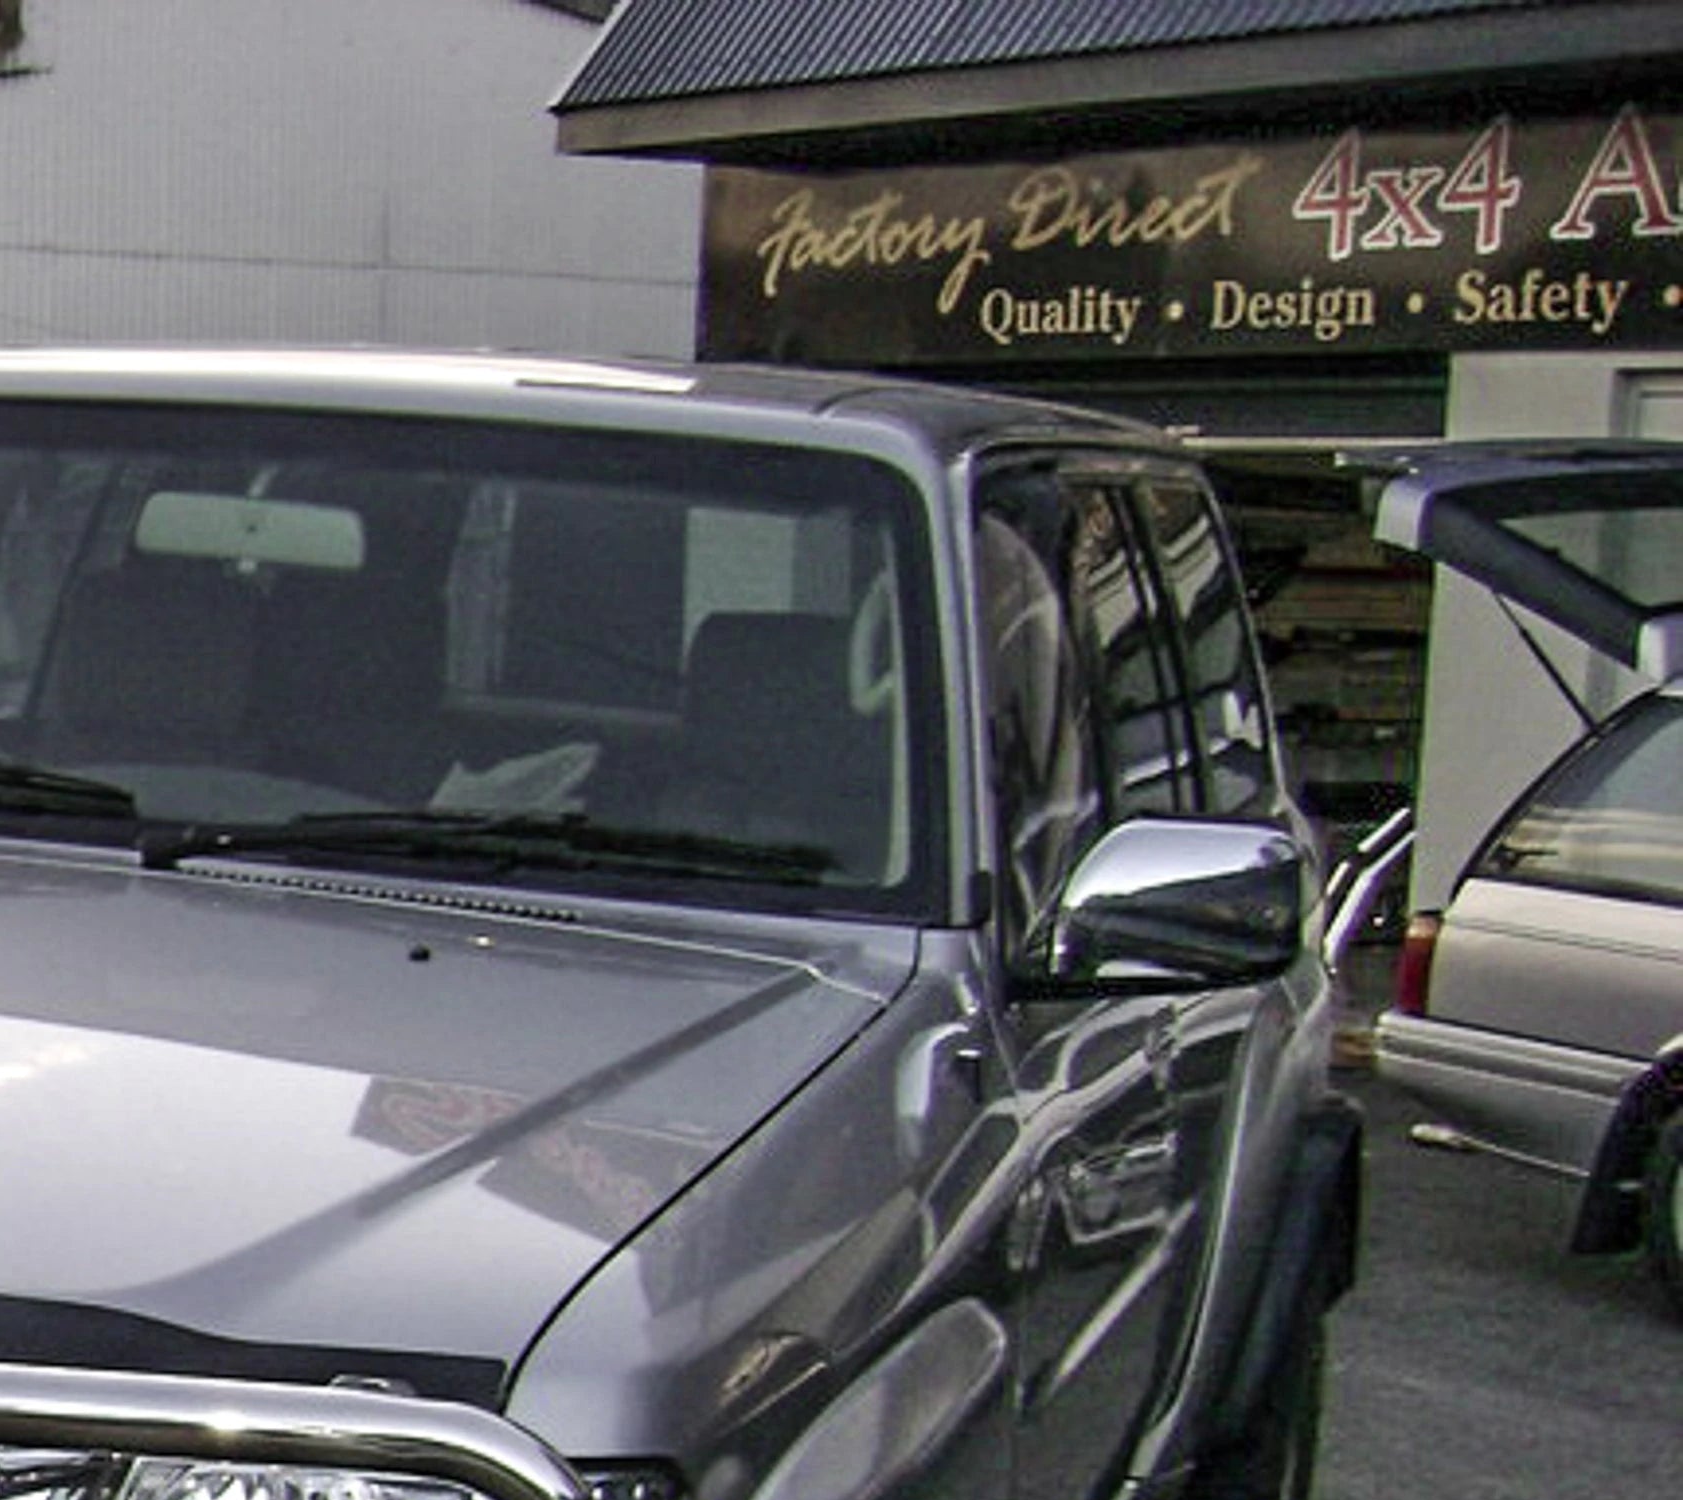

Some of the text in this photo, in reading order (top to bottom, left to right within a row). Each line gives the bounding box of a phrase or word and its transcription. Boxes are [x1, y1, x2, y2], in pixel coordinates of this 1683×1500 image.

[757, 187, 990, 314] Factory
[1008, 150, 1265, 252] Direct
[1291, 113, 1522, 262] 4x4
[980, 268, 1629, 345] Quality Design Safety
